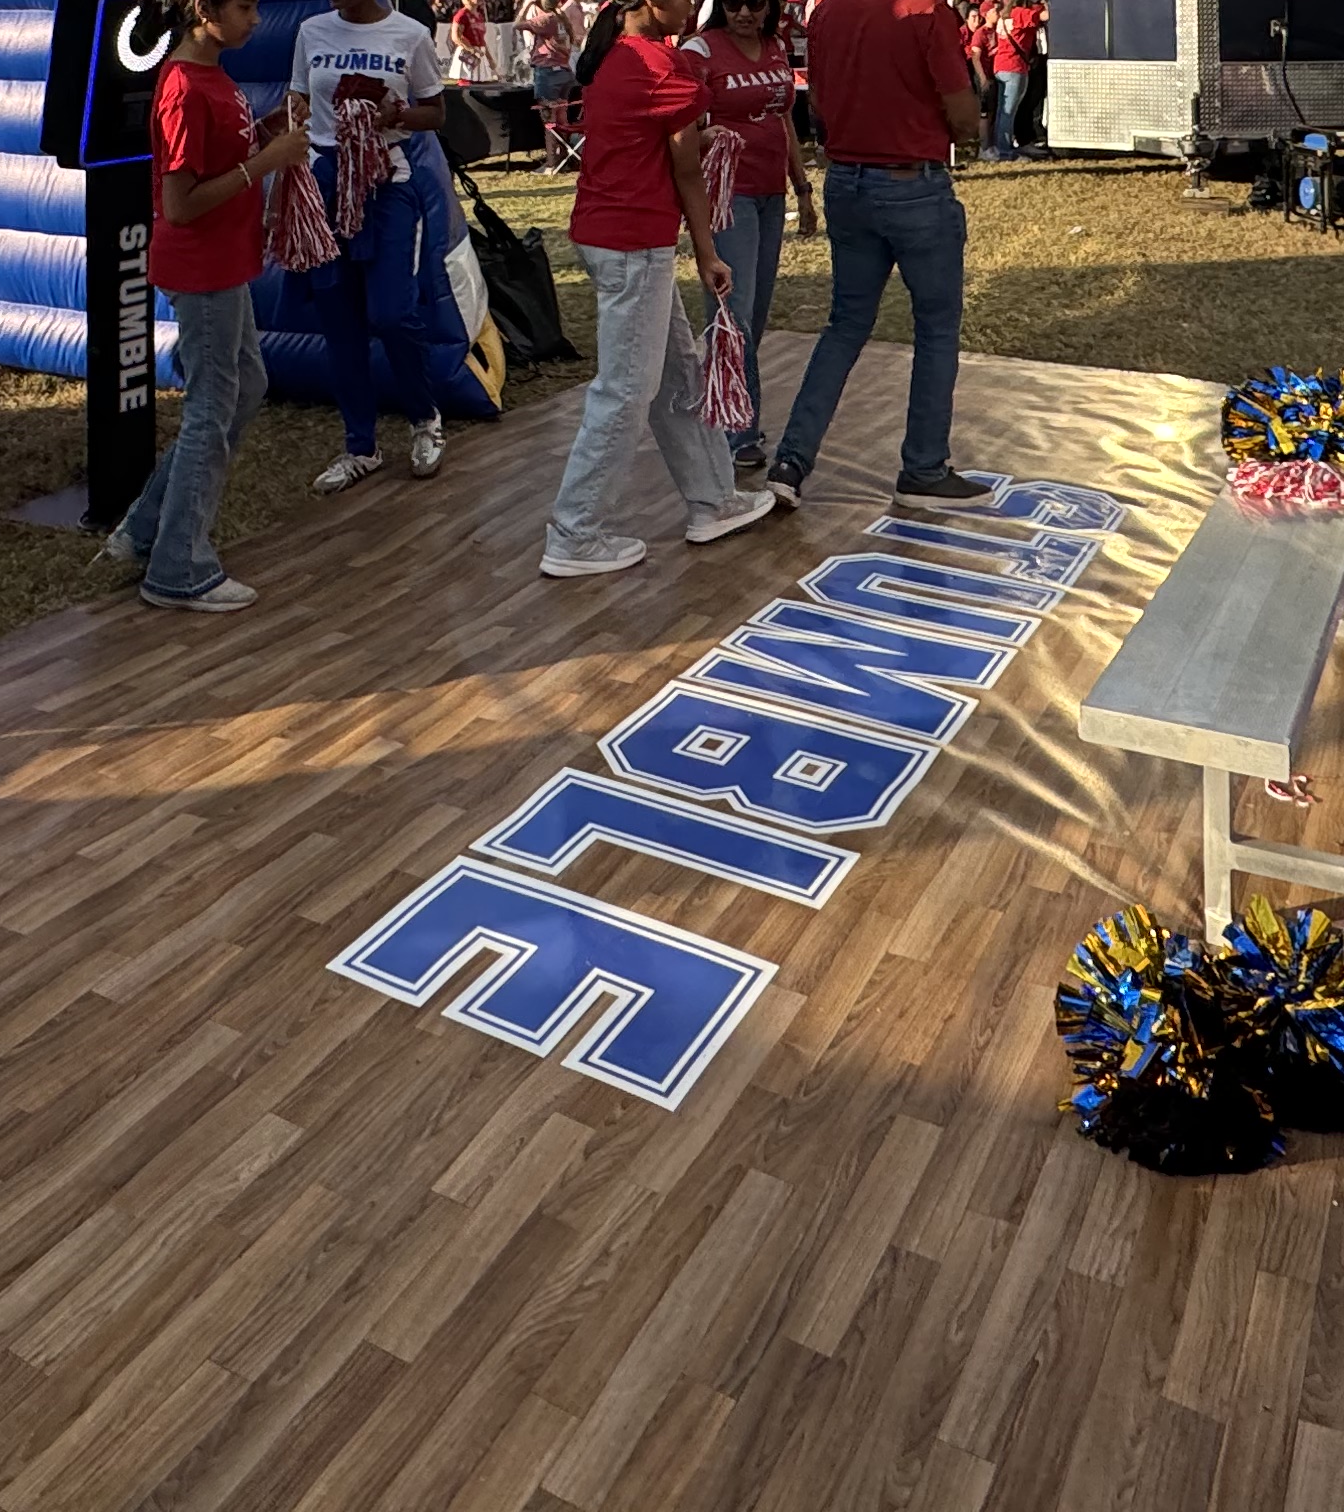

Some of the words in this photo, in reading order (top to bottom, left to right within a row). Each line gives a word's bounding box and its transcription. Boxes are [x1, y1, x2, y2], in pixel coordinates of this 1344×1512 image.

[726, 68, 793, 90] ALABAM
[119, 223, 148, 414] STUMBLE
[327, 469, 1128, 1112] STUMBLE
